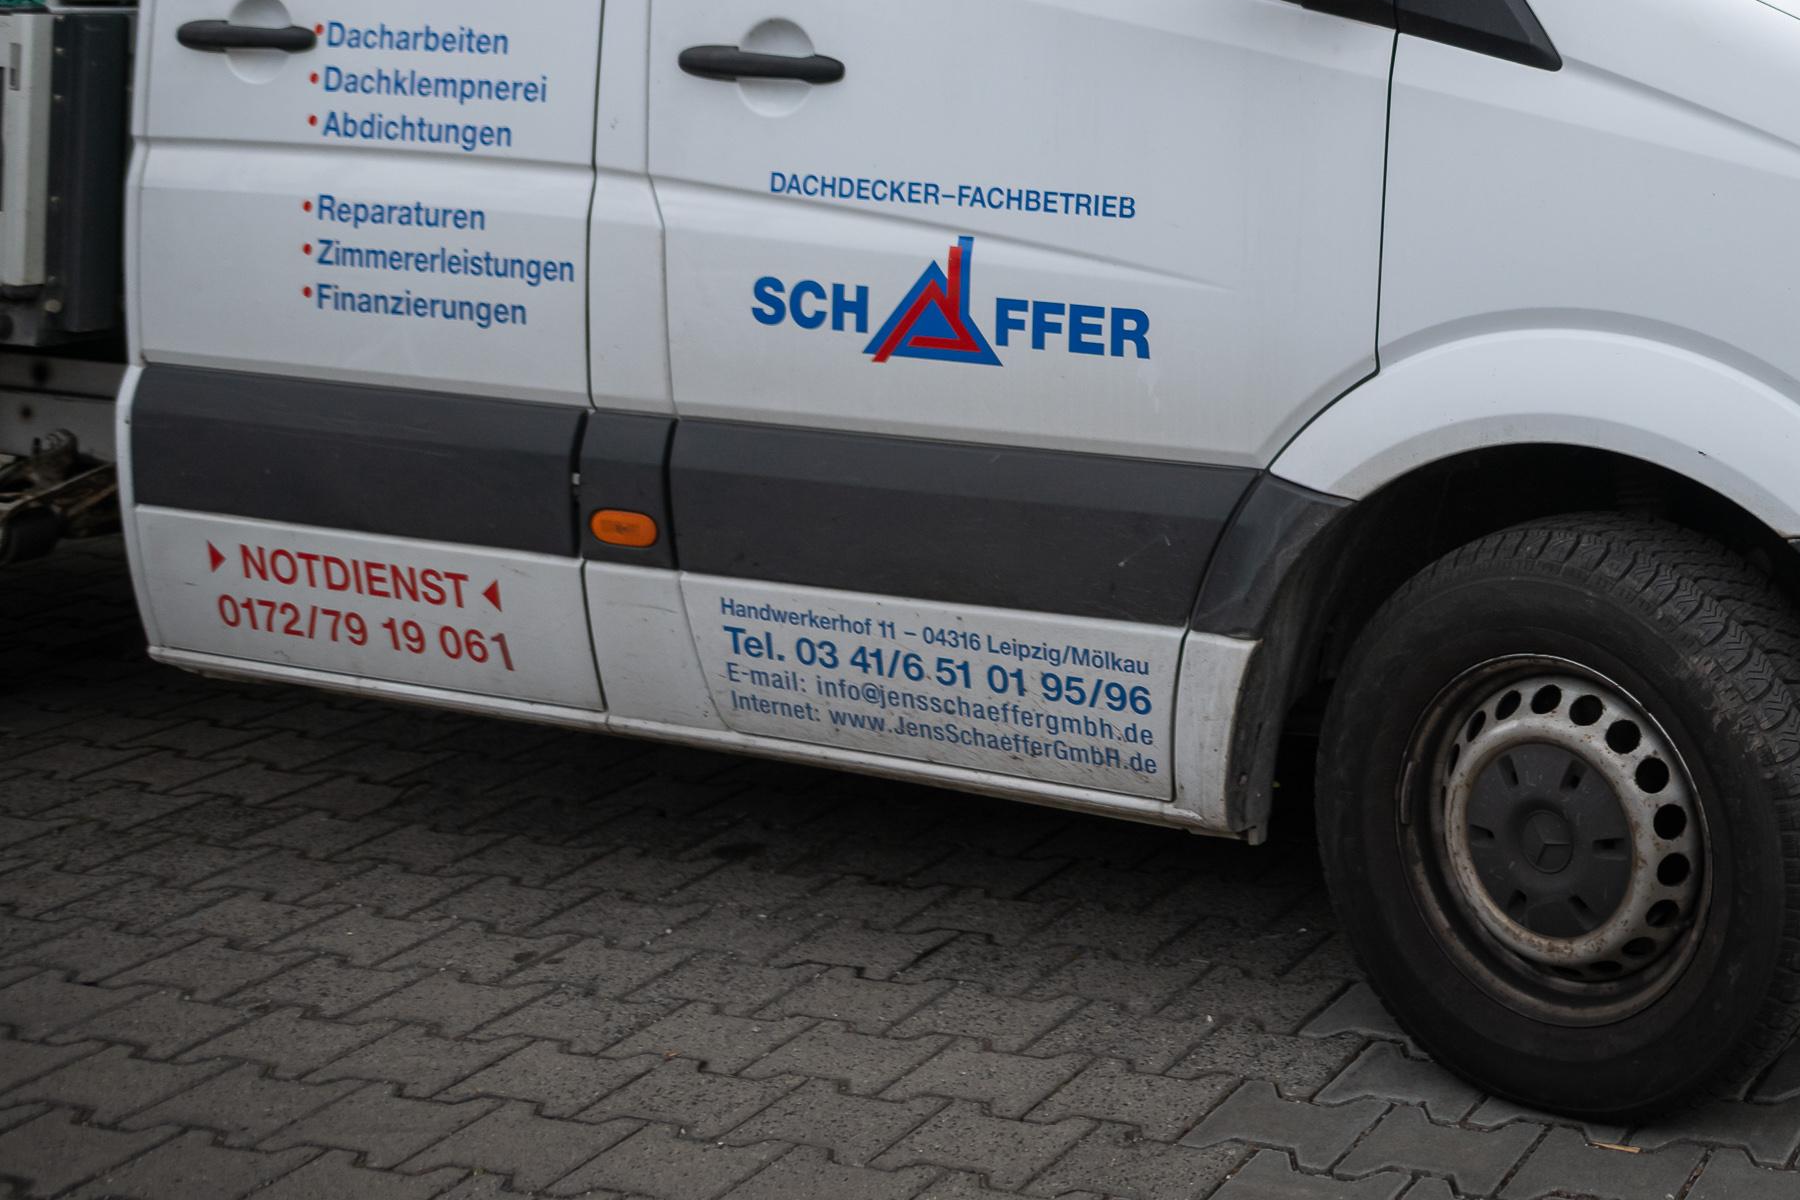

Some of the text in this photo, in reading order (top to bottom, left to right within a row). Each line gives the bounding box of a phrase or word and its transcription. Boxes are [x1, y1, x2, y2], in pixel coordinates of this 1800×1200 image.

[325, 19, 510, 56] Dacharbeiten
[321, 64, 549, 107] Dachklempnerei
[321, 110, 513, 153] Abdichtungen
[316, 192, 487, 232] Reparaturen
[769, 171, 1137, 220] DACHDECKER-FACHBETRIEB
[315, 238, 576, 288] Zimmererleistungen
[315, 283, 528, 330] Finanzierungen
[239, 543, 469, 609] NOTDIENST
[218, 594, 515, 673] 0172/79 19 061
[720, 597, 873, 636] Handwerkerhof
[878, 620, 896, 640] 11
[922, 626, 981, 652] 04316
[986, 634, 1150, 676] Leipzig/Mölkau
[722, 624, 1153, 717] Tel. 03 41/6 51 01 95/96
[726, 662, 1154, 746] E-mail: info@jensschaeffergmbh.de
[731, 689, 1158, 775] Internet: www.JensSchaefferGmbH.de
